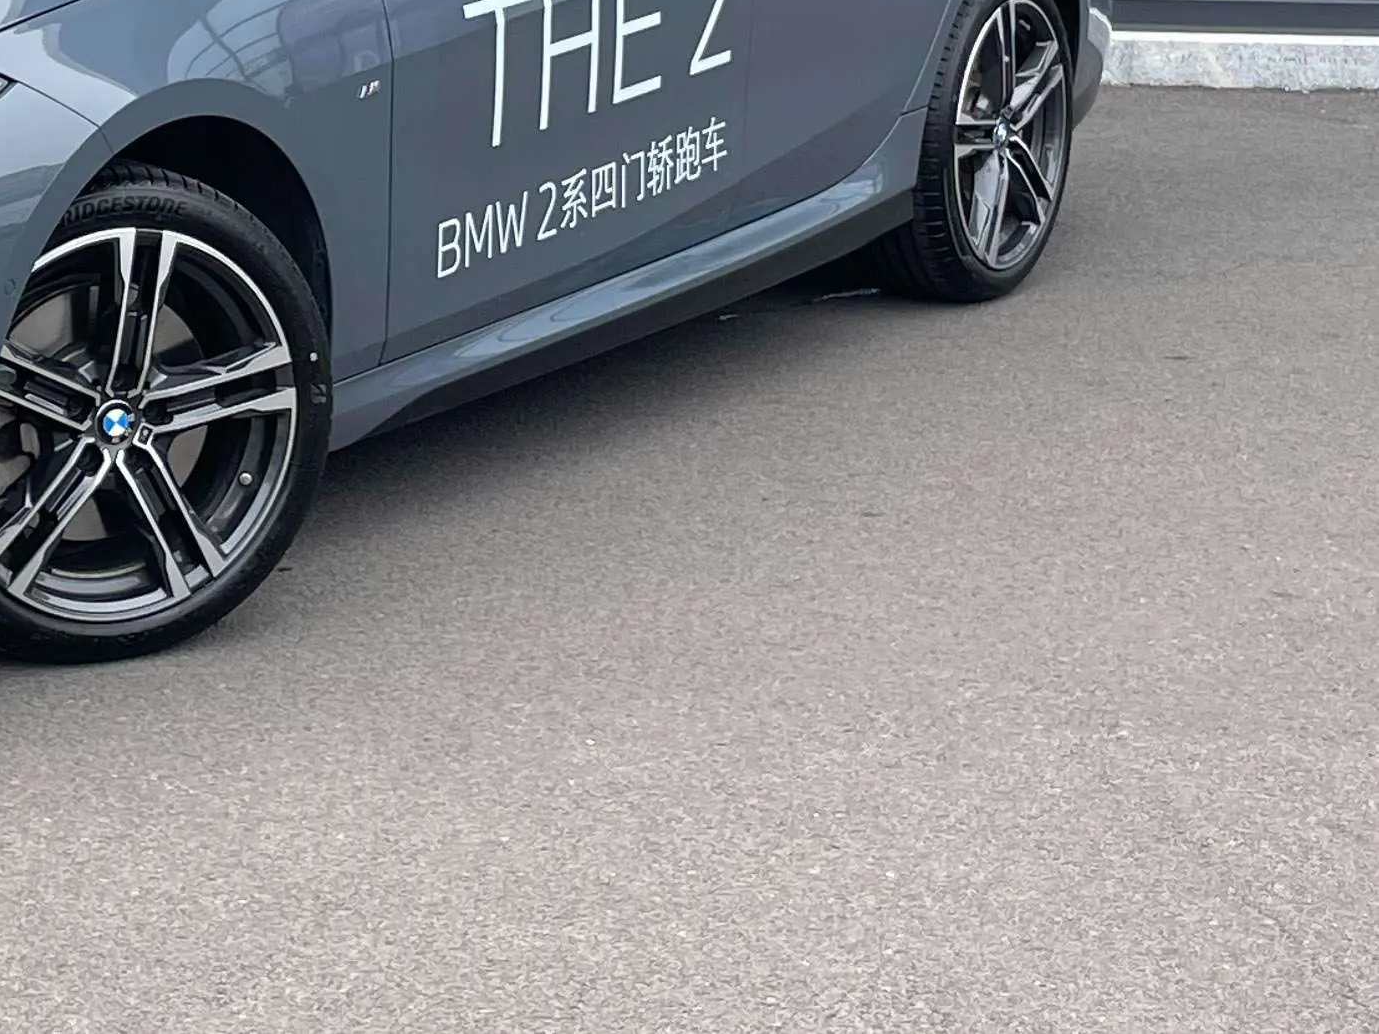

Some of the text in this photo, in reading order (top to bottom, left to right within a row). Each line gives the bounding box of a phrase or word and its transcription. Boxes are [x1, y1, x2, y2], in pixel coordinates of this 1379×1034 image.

[62, 195, 188, 226] RIDGESTONE
[436, 116, 728, 279] BMW 2系四门轿跑车
